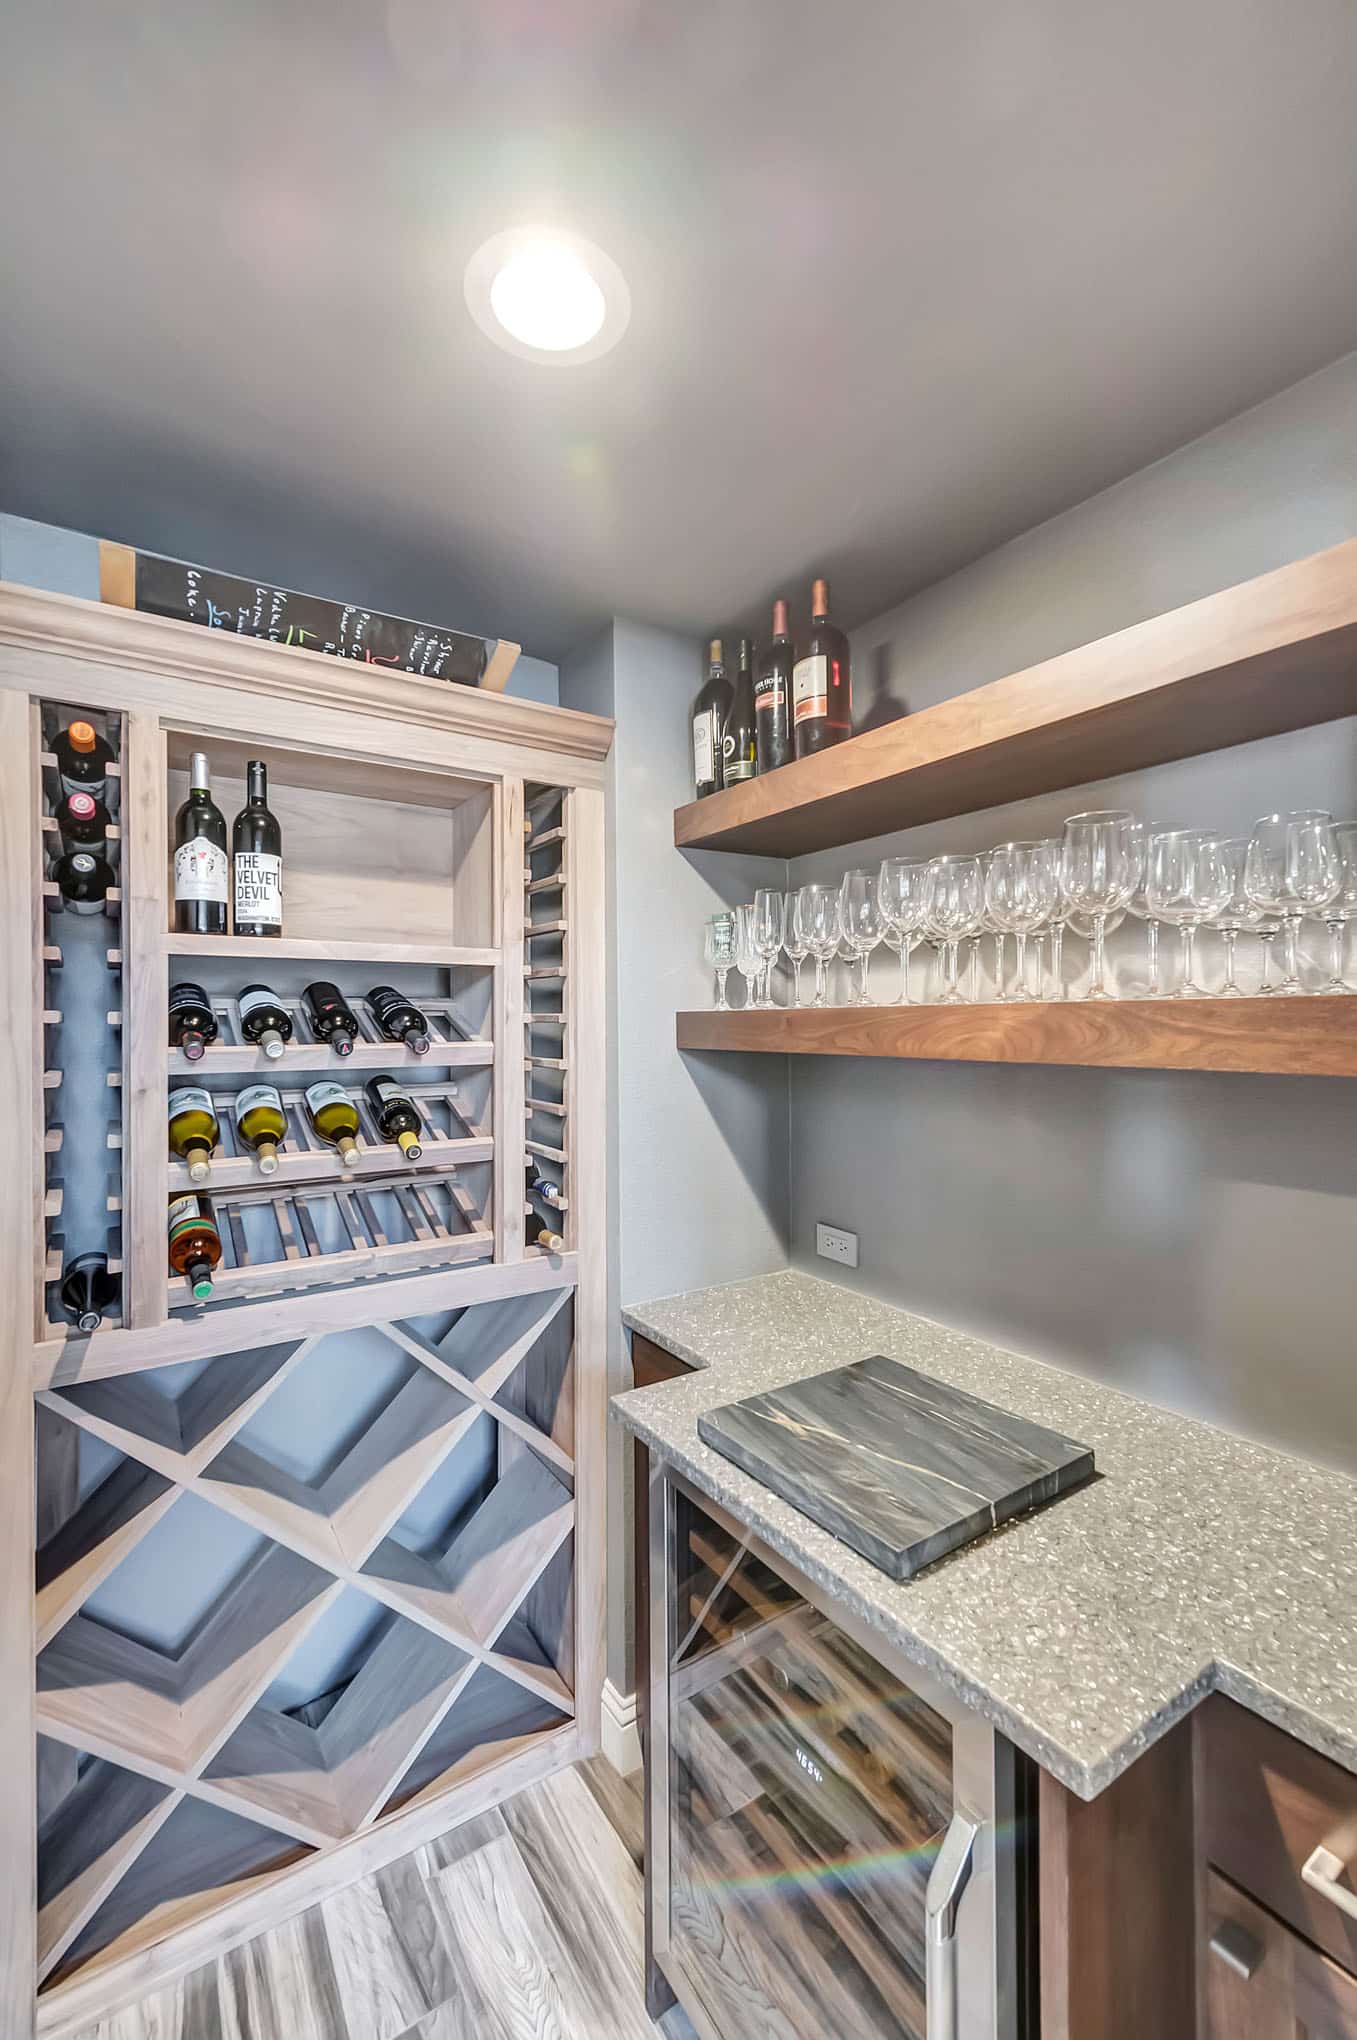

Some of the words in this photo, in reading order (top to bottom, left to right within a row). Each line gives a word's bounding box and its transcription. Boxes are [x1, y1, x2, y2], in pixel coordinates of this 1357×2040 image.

[187, 570, 202, 607] Coke
[237, 854, 260, 869] THE
[237, 870, 278, 886] VELVET
[237, 885, 270, 901] DEVIL
